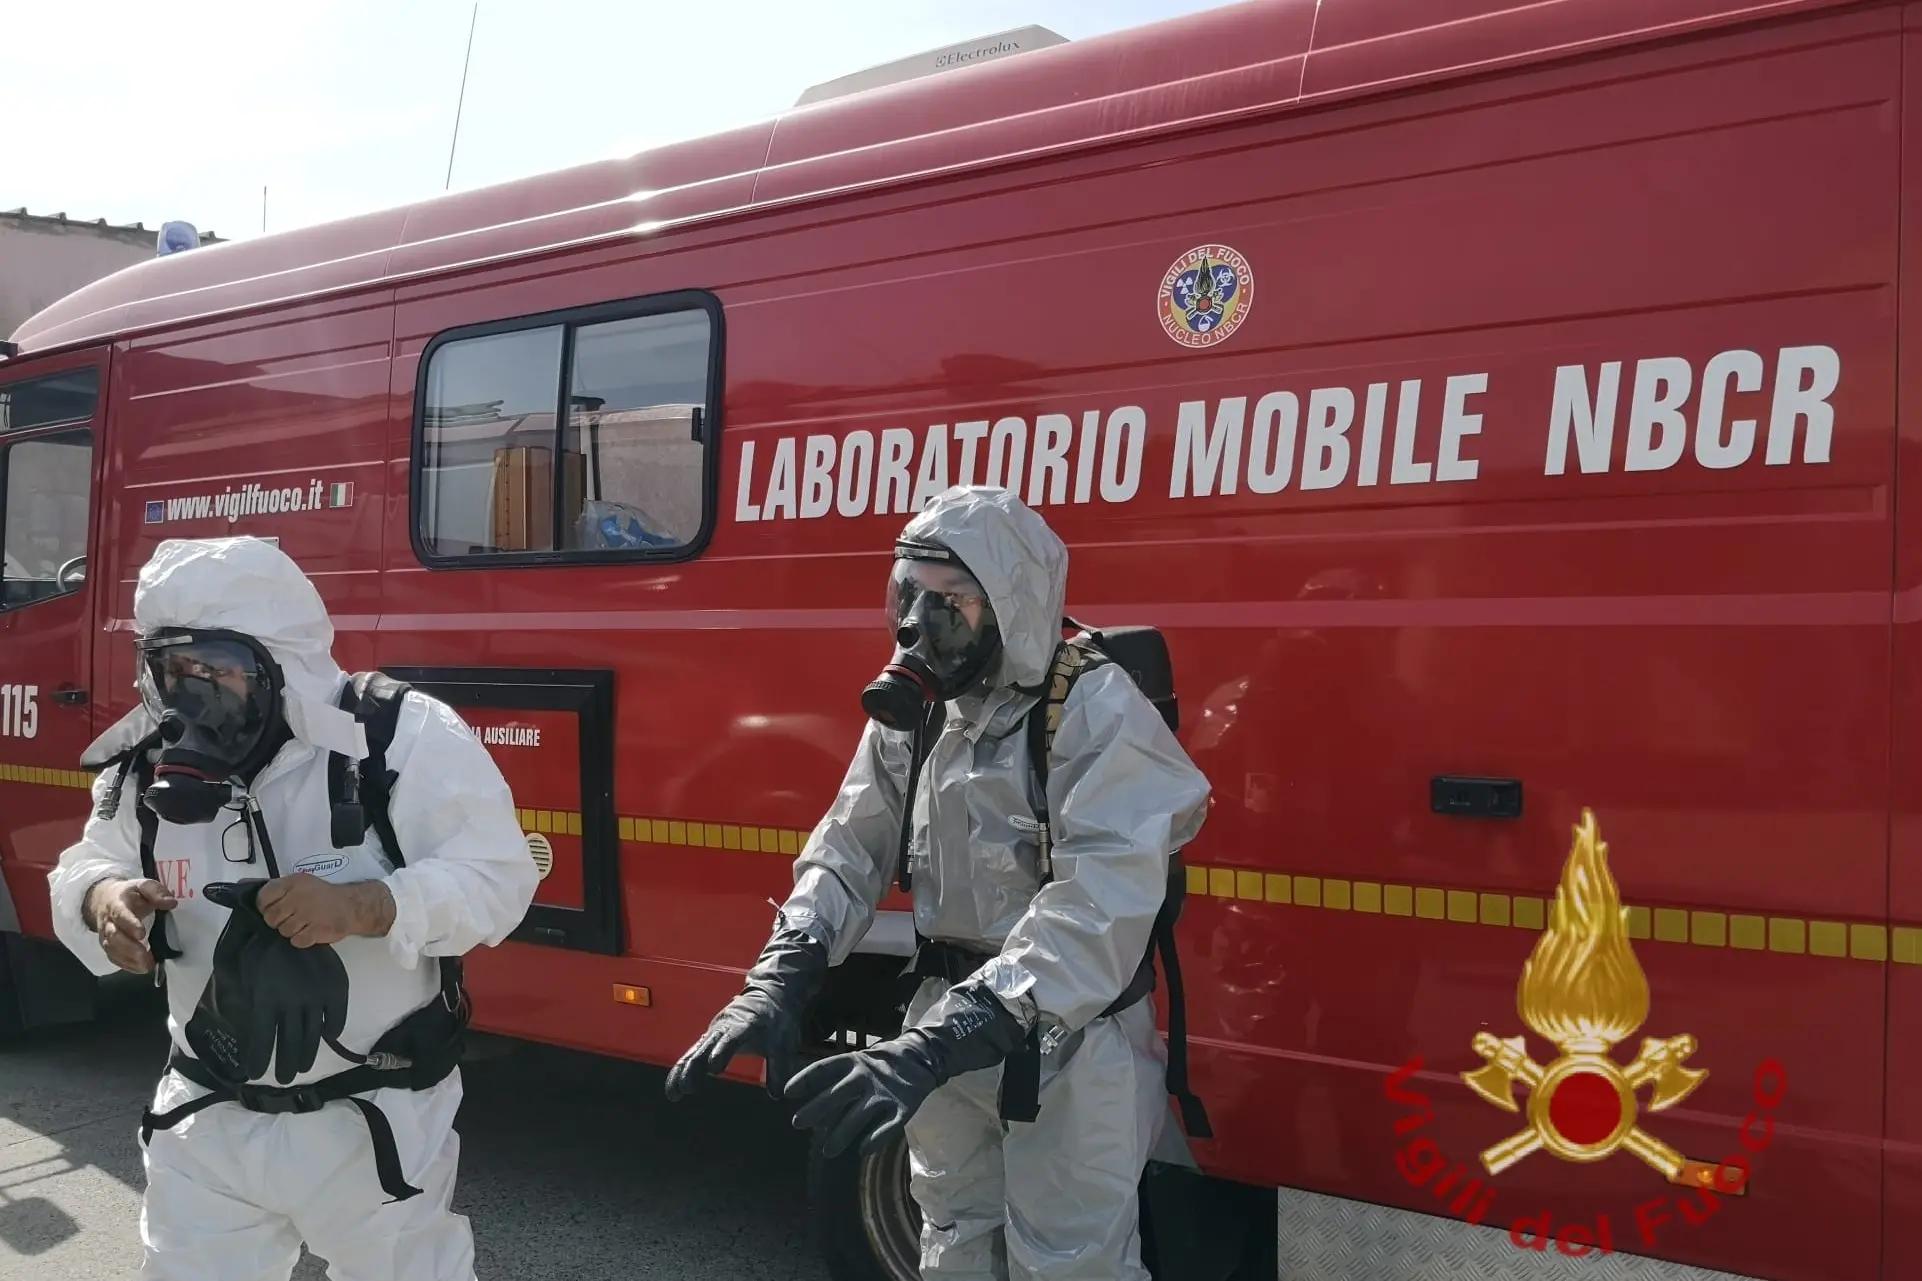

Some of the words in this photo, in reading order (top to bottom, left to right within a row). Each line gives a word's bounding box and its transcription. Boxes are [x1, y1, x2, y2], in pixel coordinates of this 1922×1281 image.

[947, 42, 1020, 65] Electrolux
[1161, 260, 1187, 298] VIGILI
[1188, 247, 1213, 263] DEL
[1216, 248, 1250, 285] FUOCO
[1163, 313, 1210, 345] NUCLEO
[1214, 302, 1248, 340] NBCR
[735, 405, 1146, 522] LABORATORIO
[1169, 373, 1488, 498] MOBILE
[1544, 345, 1840, 476] NBCR
[167, 478, 323, 523] www.vigilfuoco.it
[1, 684, 38, 738] 115
[484, 727, 540, 747] AUSILIARE
